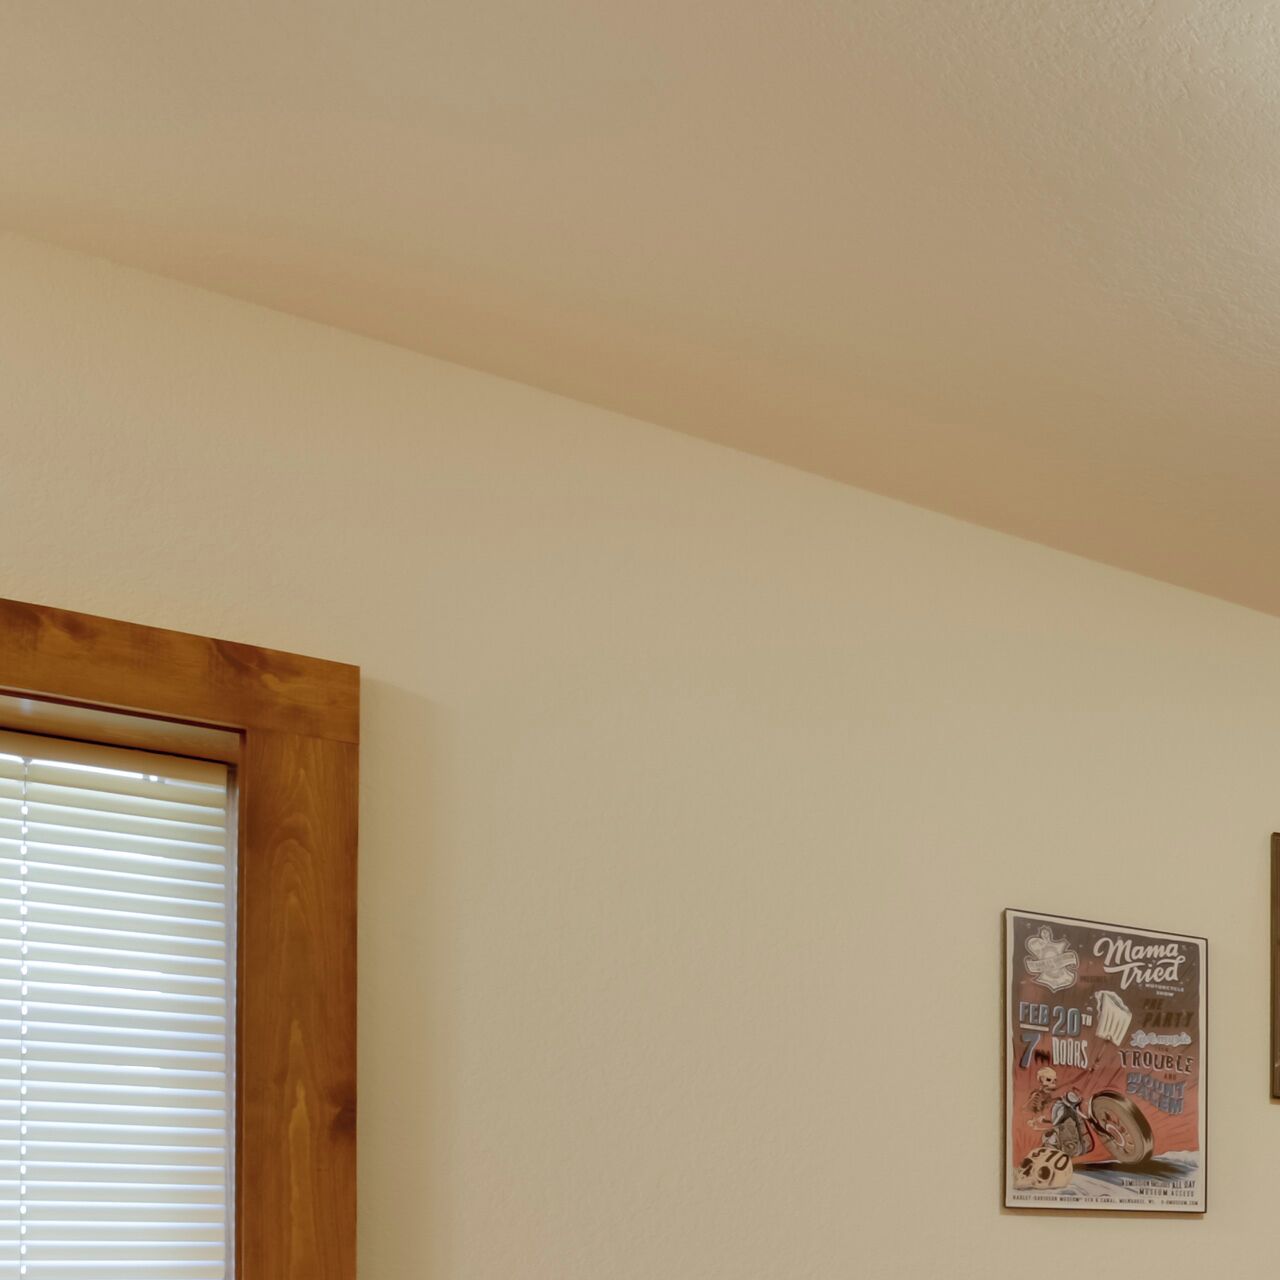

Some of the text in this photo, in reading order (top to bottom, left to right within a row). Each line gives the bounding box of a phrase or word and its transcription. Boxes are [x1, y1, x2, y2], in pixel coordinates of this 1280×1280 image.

[1093, 937, 1180, 966] Mama
[1104, 955, 1186, 990] Tried
[1052, 1037, 1089, 1070] DOORS
[1119, 1049, 1194, 1075] TROUBLE
